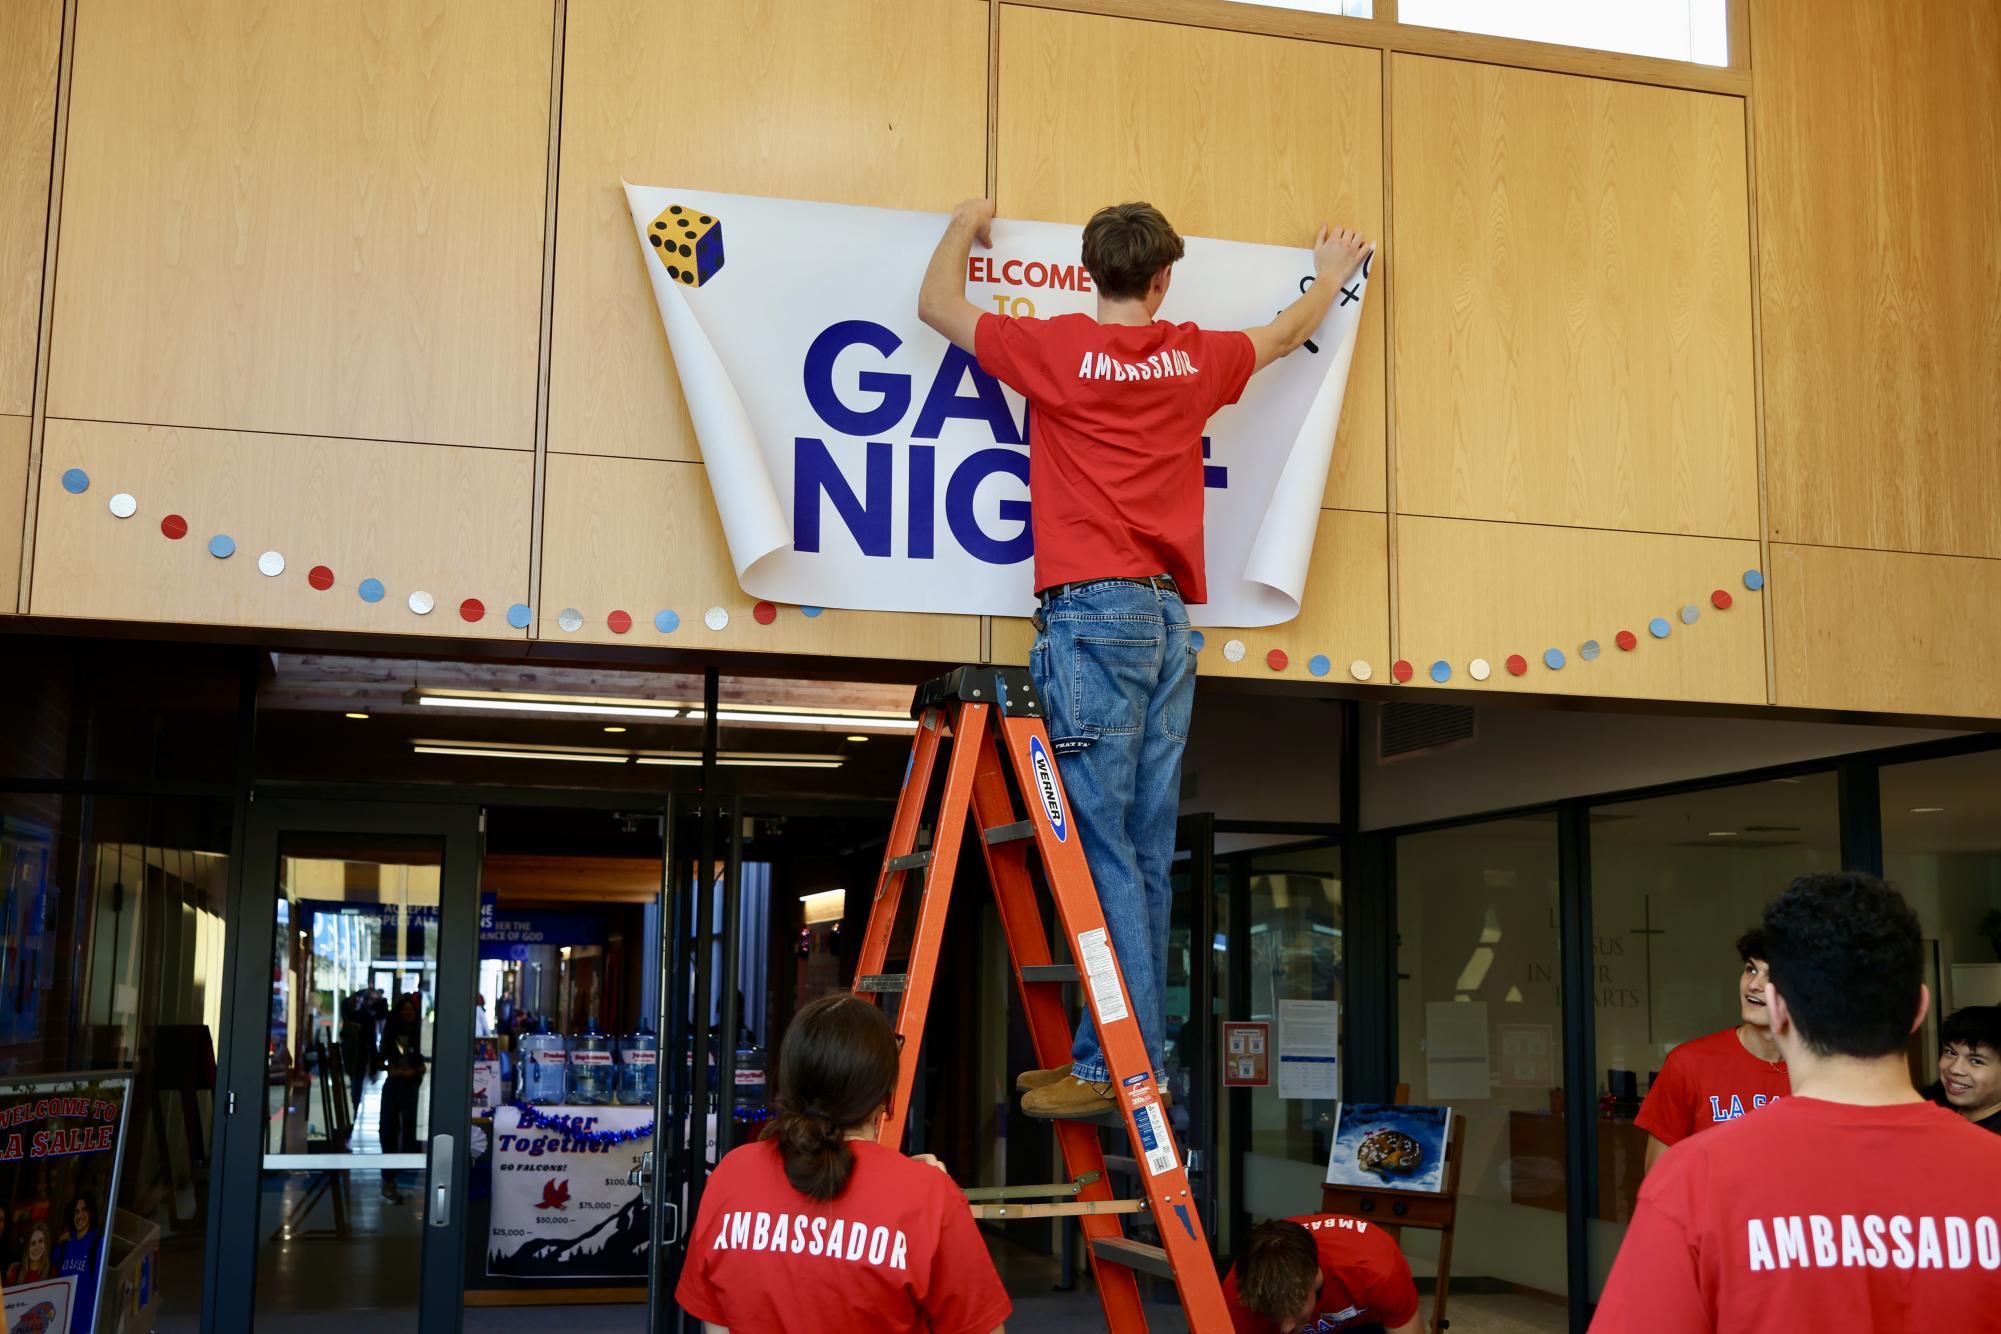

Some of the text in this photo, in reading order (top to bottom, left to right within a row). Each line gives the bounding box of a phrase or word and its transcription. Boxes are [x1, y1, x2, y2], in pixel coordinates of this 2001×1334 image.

[968, 256, 1092, 293] ELCOME
[992, 295, 1036, 320] TO
[1036, 758, 1061, 821] WERNER
[384, 904, 428, 914] ACEPT
[521, 931, 544, 942] GOD
[1528, 963, 1551, 982] IN
[0, 1098, 117, 1128] WELCOME TO
[1709, 1094, 1746, 1122] LA
[516, 1112, 598, 1132] Btter
[0, 1126, 113, 1158] A SALLE
[500, 1163, 568, 1173] GO FALCONS!
[605, 1178, 636, 1187] $100,
[578, 1201, 611, 1210] $75,000
[536, 1216, 568, 1225] $50,000
[493, 1228, 525, 1237] $25,000
[713, 1211, 907, 1270] AMBASSADOR
[1747, 1214, 2001, 1271] AMBASSADO
